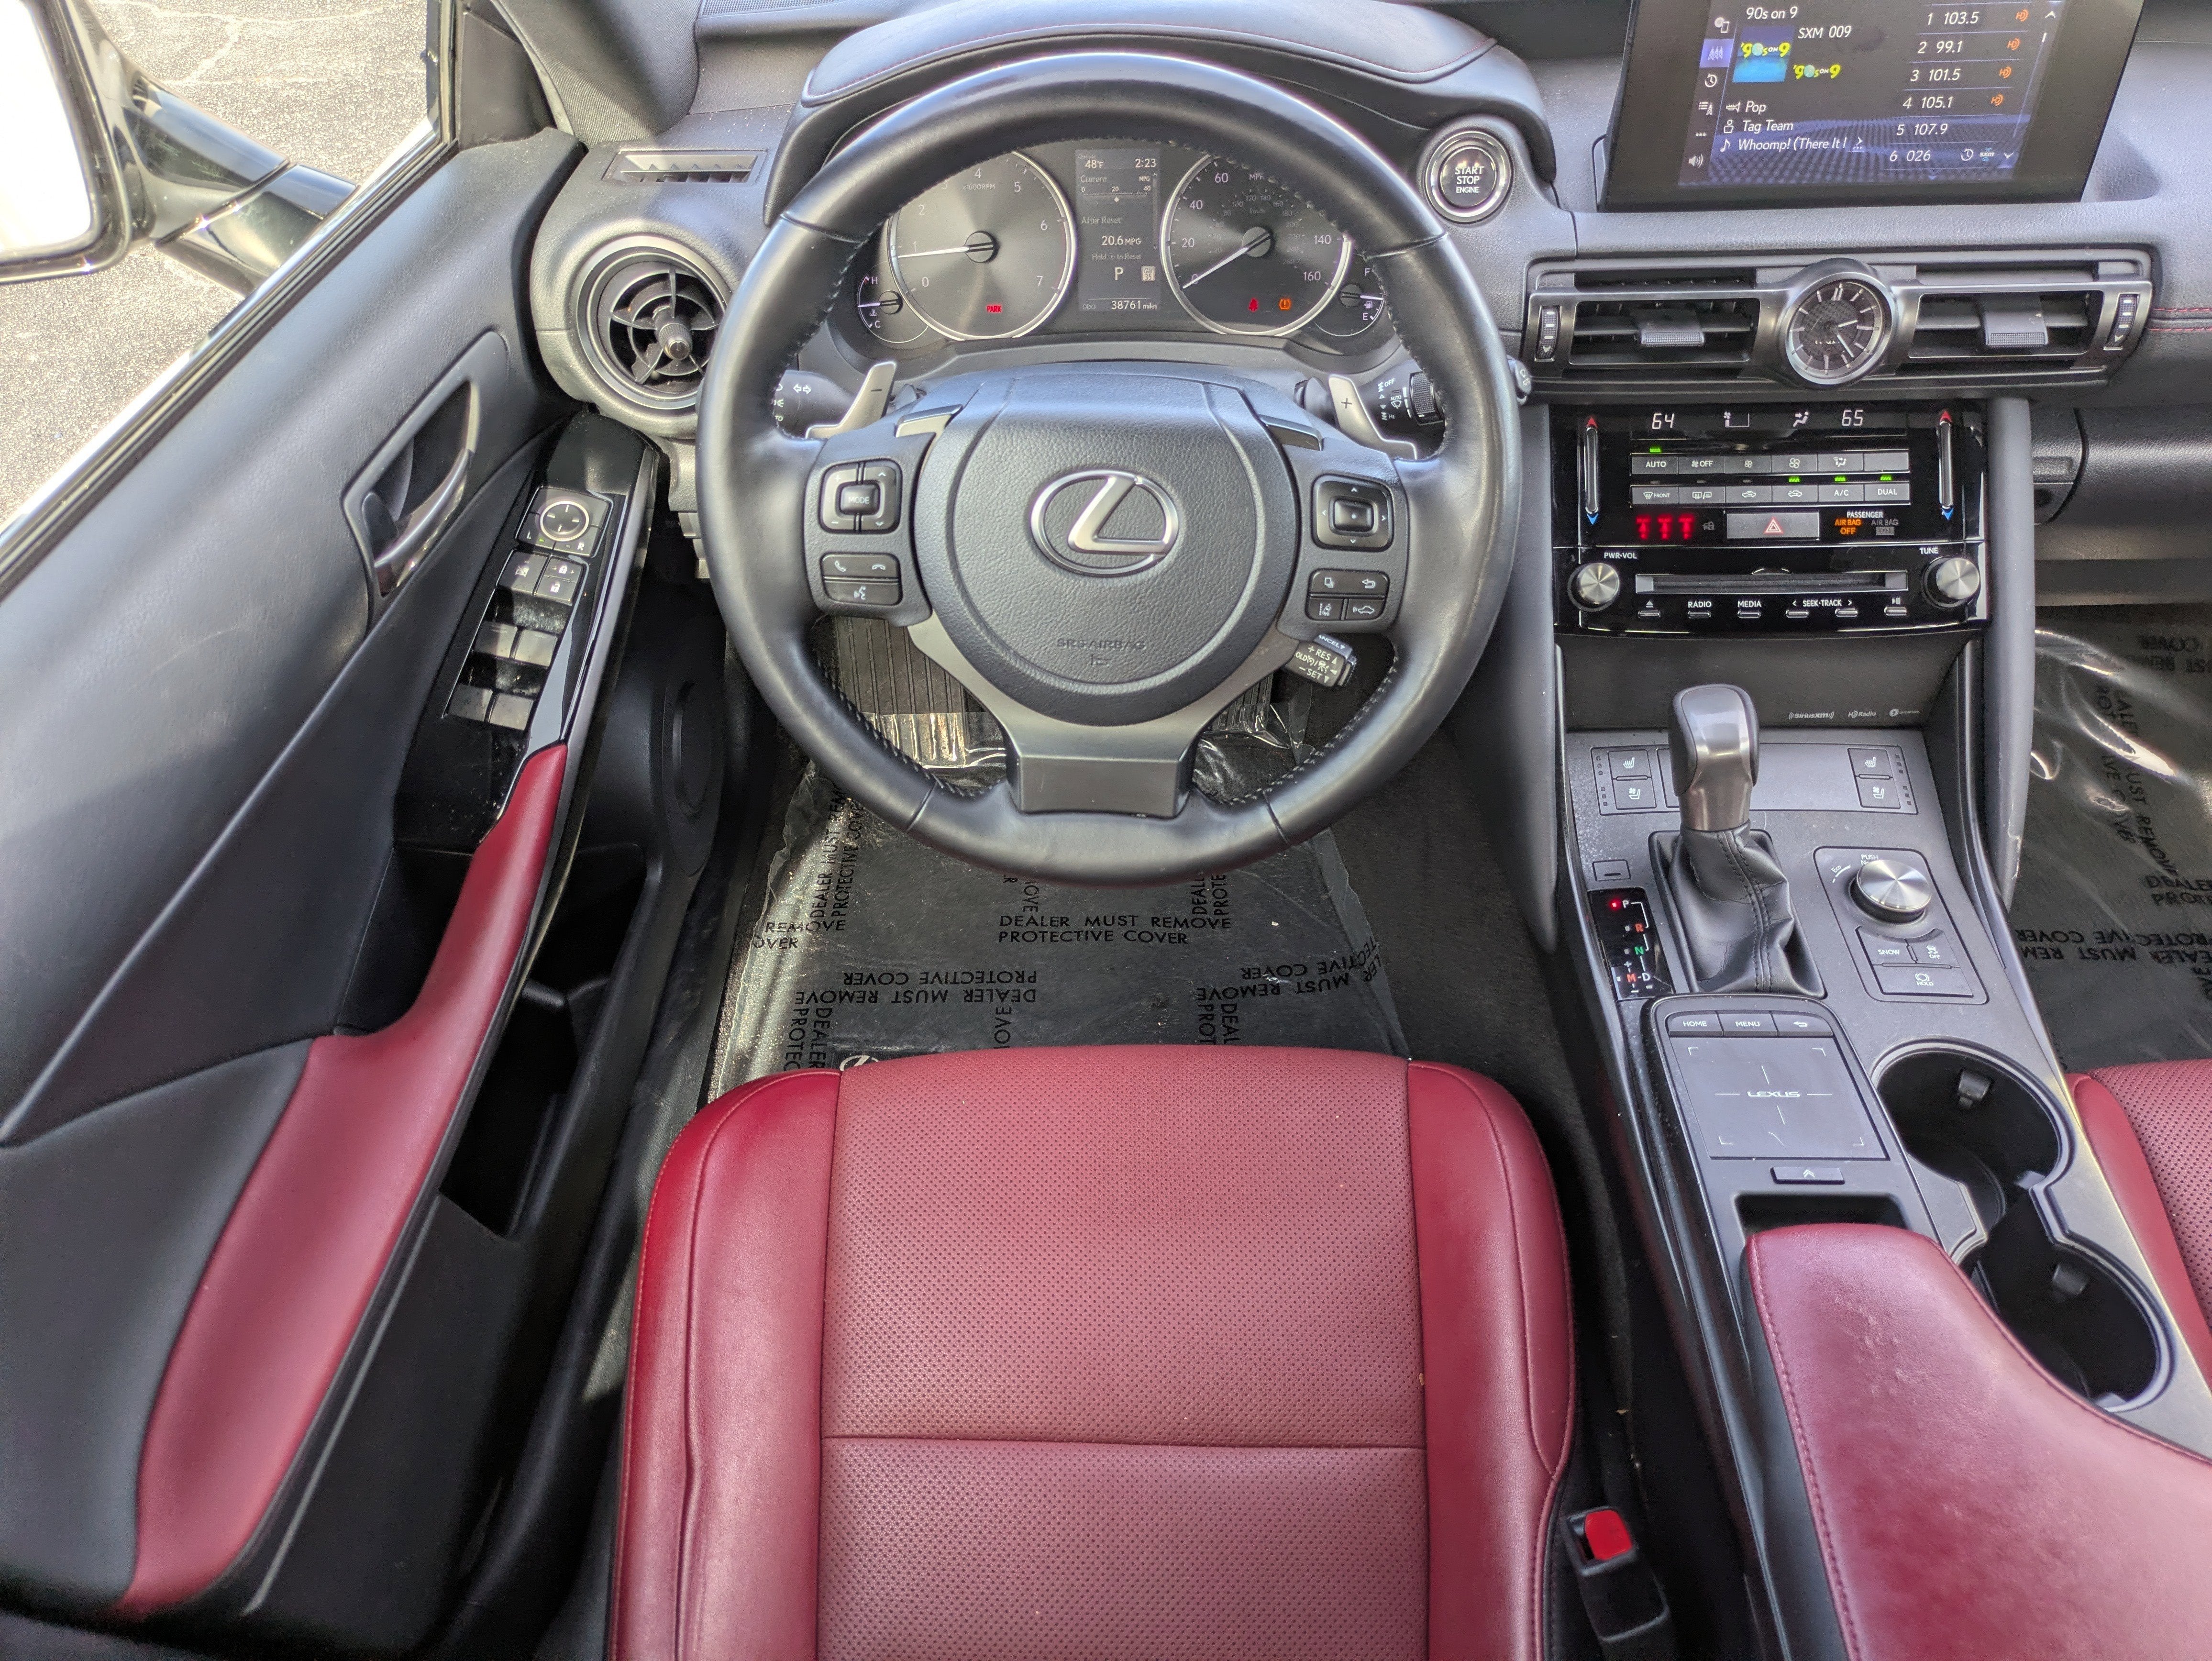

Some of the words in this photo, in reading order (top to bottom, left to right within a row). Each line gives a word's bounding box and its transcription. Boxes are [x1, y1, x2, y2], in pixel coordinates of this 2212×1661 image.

[1747, 7, 1768, 20] 90s
[1771, 9, 1785, 19] on
[1789, 6, 1798, 19] 9
[1927, 13, 1933, 25] 1
[1944, 12, 1980, 25] 103.5
[1798, 27, 1823, 39] SXM
[1829, 25, 1851, 38] 009
[1917, 42, 1927, 54] 2
[1936, 40, 1963, 54] 99.1
[1910, 69, 1919, 82] 3
[1928, 68, 1961, 81] 101.5
[1745, 101, 1767, 114] Pop
[1902, 97, 1912, 109] 4
[1921, 96, 1954, 109] 105.1
[1742, 120, 1761, 134] Tag
[1766, 120, 1793, 132] Team
[1896, 124, 1904, 136] 5
[1914, 123, 1948, 135] 107.9
[1738, 138, 1790, 153] Whoomp!
[1793, 137, 1829, 152] (There
[1833, 137, 1842, 149] It
[1889, 150, 1898, 162] 6
[1906, 150, 1931, 162] 026
[1135, 158, 1157, 168] 2:23
[974, 168, 982, 178] 4
[1455, 166, 1485, 175] START
[1215, 172, 1228, 183] 60
[1456, 176, 1480, 185] STOP
[1014, 181, 1021, 192] 5
[918, 205, 926, 215] 2
[1189, 200, 1203, 210] 40
[1040, 221, 1048, 231] 6
[1101, 235, 1124, 246] 20.6
[1181, 238, 1195, 248] 20
[1314, 234, 1332, 244] 140
[913, 241, 918, 253] 1
[1114, 266, 1124, 281] P
[1303, 271, 1321, 282] 160
[1364, 267, 1371, 277] F
[921, 277, 929, 288] 0
[1036, 275, 1044, 286] 7
[986, 305, 1002, 313] PARK
[1111, 300, 1141, 310] 38761
[1362, 312, 1369, 321] E
[874, 321, 881, 329] C
[1384, 378, 1395, 387] OFF
[1651, 412, 1675, 430] 64
[1841, 409, 1864, 427] 65
[848, 496, 870, 504] MODE
[527, 531, 532, 539] L
[1840, 527, 1857, 535] OFF
[576, 542, 585, 551] R
[1688, 600, 1712, 609] RADIO
[1737, 600, 1762, 609] MEDIA
[1318, 634, 1340, 649] ANCEL
[1295, 651, 1308, 662] OLD
[1315, 648, 1332, 661] RES
[1306, 668, 1324, 680] SET
[1831, 864, 1842, 874] Eco
[809, 872, 833, 919] DEALER
[1189, 875, 1208, 916] DEAL
[1622, 899, 1629, 909] P
[1000, 914, 1070, 928] DEALER
[1084, 914, 1139, 928] MUST
[1151, 915, 1231, 930] REMOVE
[1634, 923, 1645, 933] R
[998, 930, 1115, 943] PROTECTIVE
[1123, 930, 1189, 945] COVER
[2015, 929, 2084, 944] COVER
[752, 936, 798, 950] OVER
[1634, 946, 1645, 955] N
[2021, 946, 2063, 961] REM
[1241, 963, 1308, 980] COVER
[843, 972, 909, 985] COVER
[919, 970, 1038, 985] PROTECTIVE
[1626, 973, 1637, 983] M
[1641, 973, 1651, 982] D
[1295, 973, 1349, 994] MUST
[891, 990, 948, 1004] MUST
[963, 989, 1037, 1003] DEALER
[1196, 982, 1281, 1001] REMOVE
[796, 990, 879, 1005] REMOVE
[1222, 1003, 1240, 1044] DEAL
